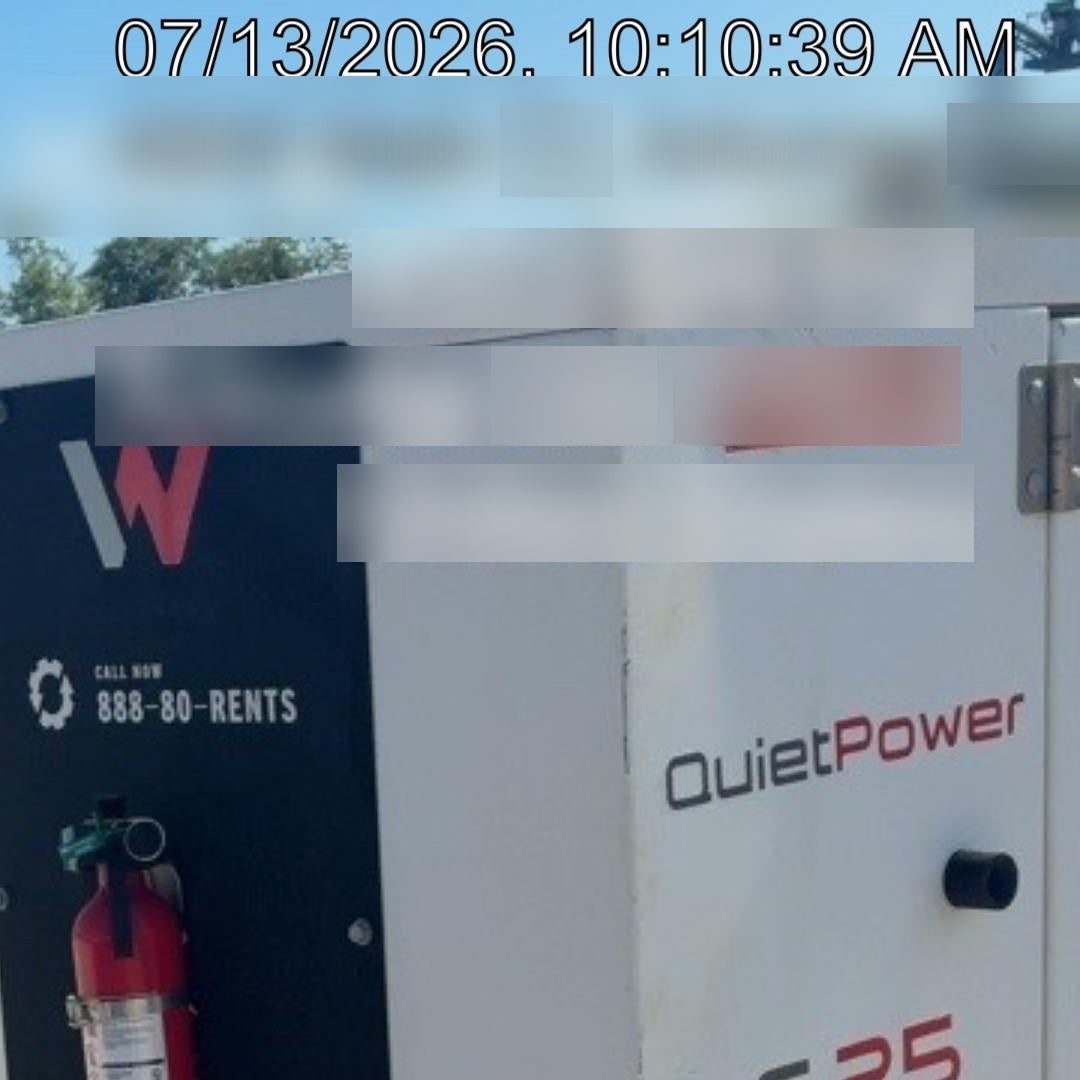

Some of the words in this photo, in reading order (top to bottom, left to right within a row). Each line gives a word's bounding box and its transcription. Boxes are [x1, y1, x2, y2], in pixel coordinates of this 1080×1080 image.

[94, 665, 128, 680] CALL
[131, 662, 163, 680] NOW
[97, 688, 298, 724] 888-80-RENTS
[664, 692, 1025, 811] QuietPower
